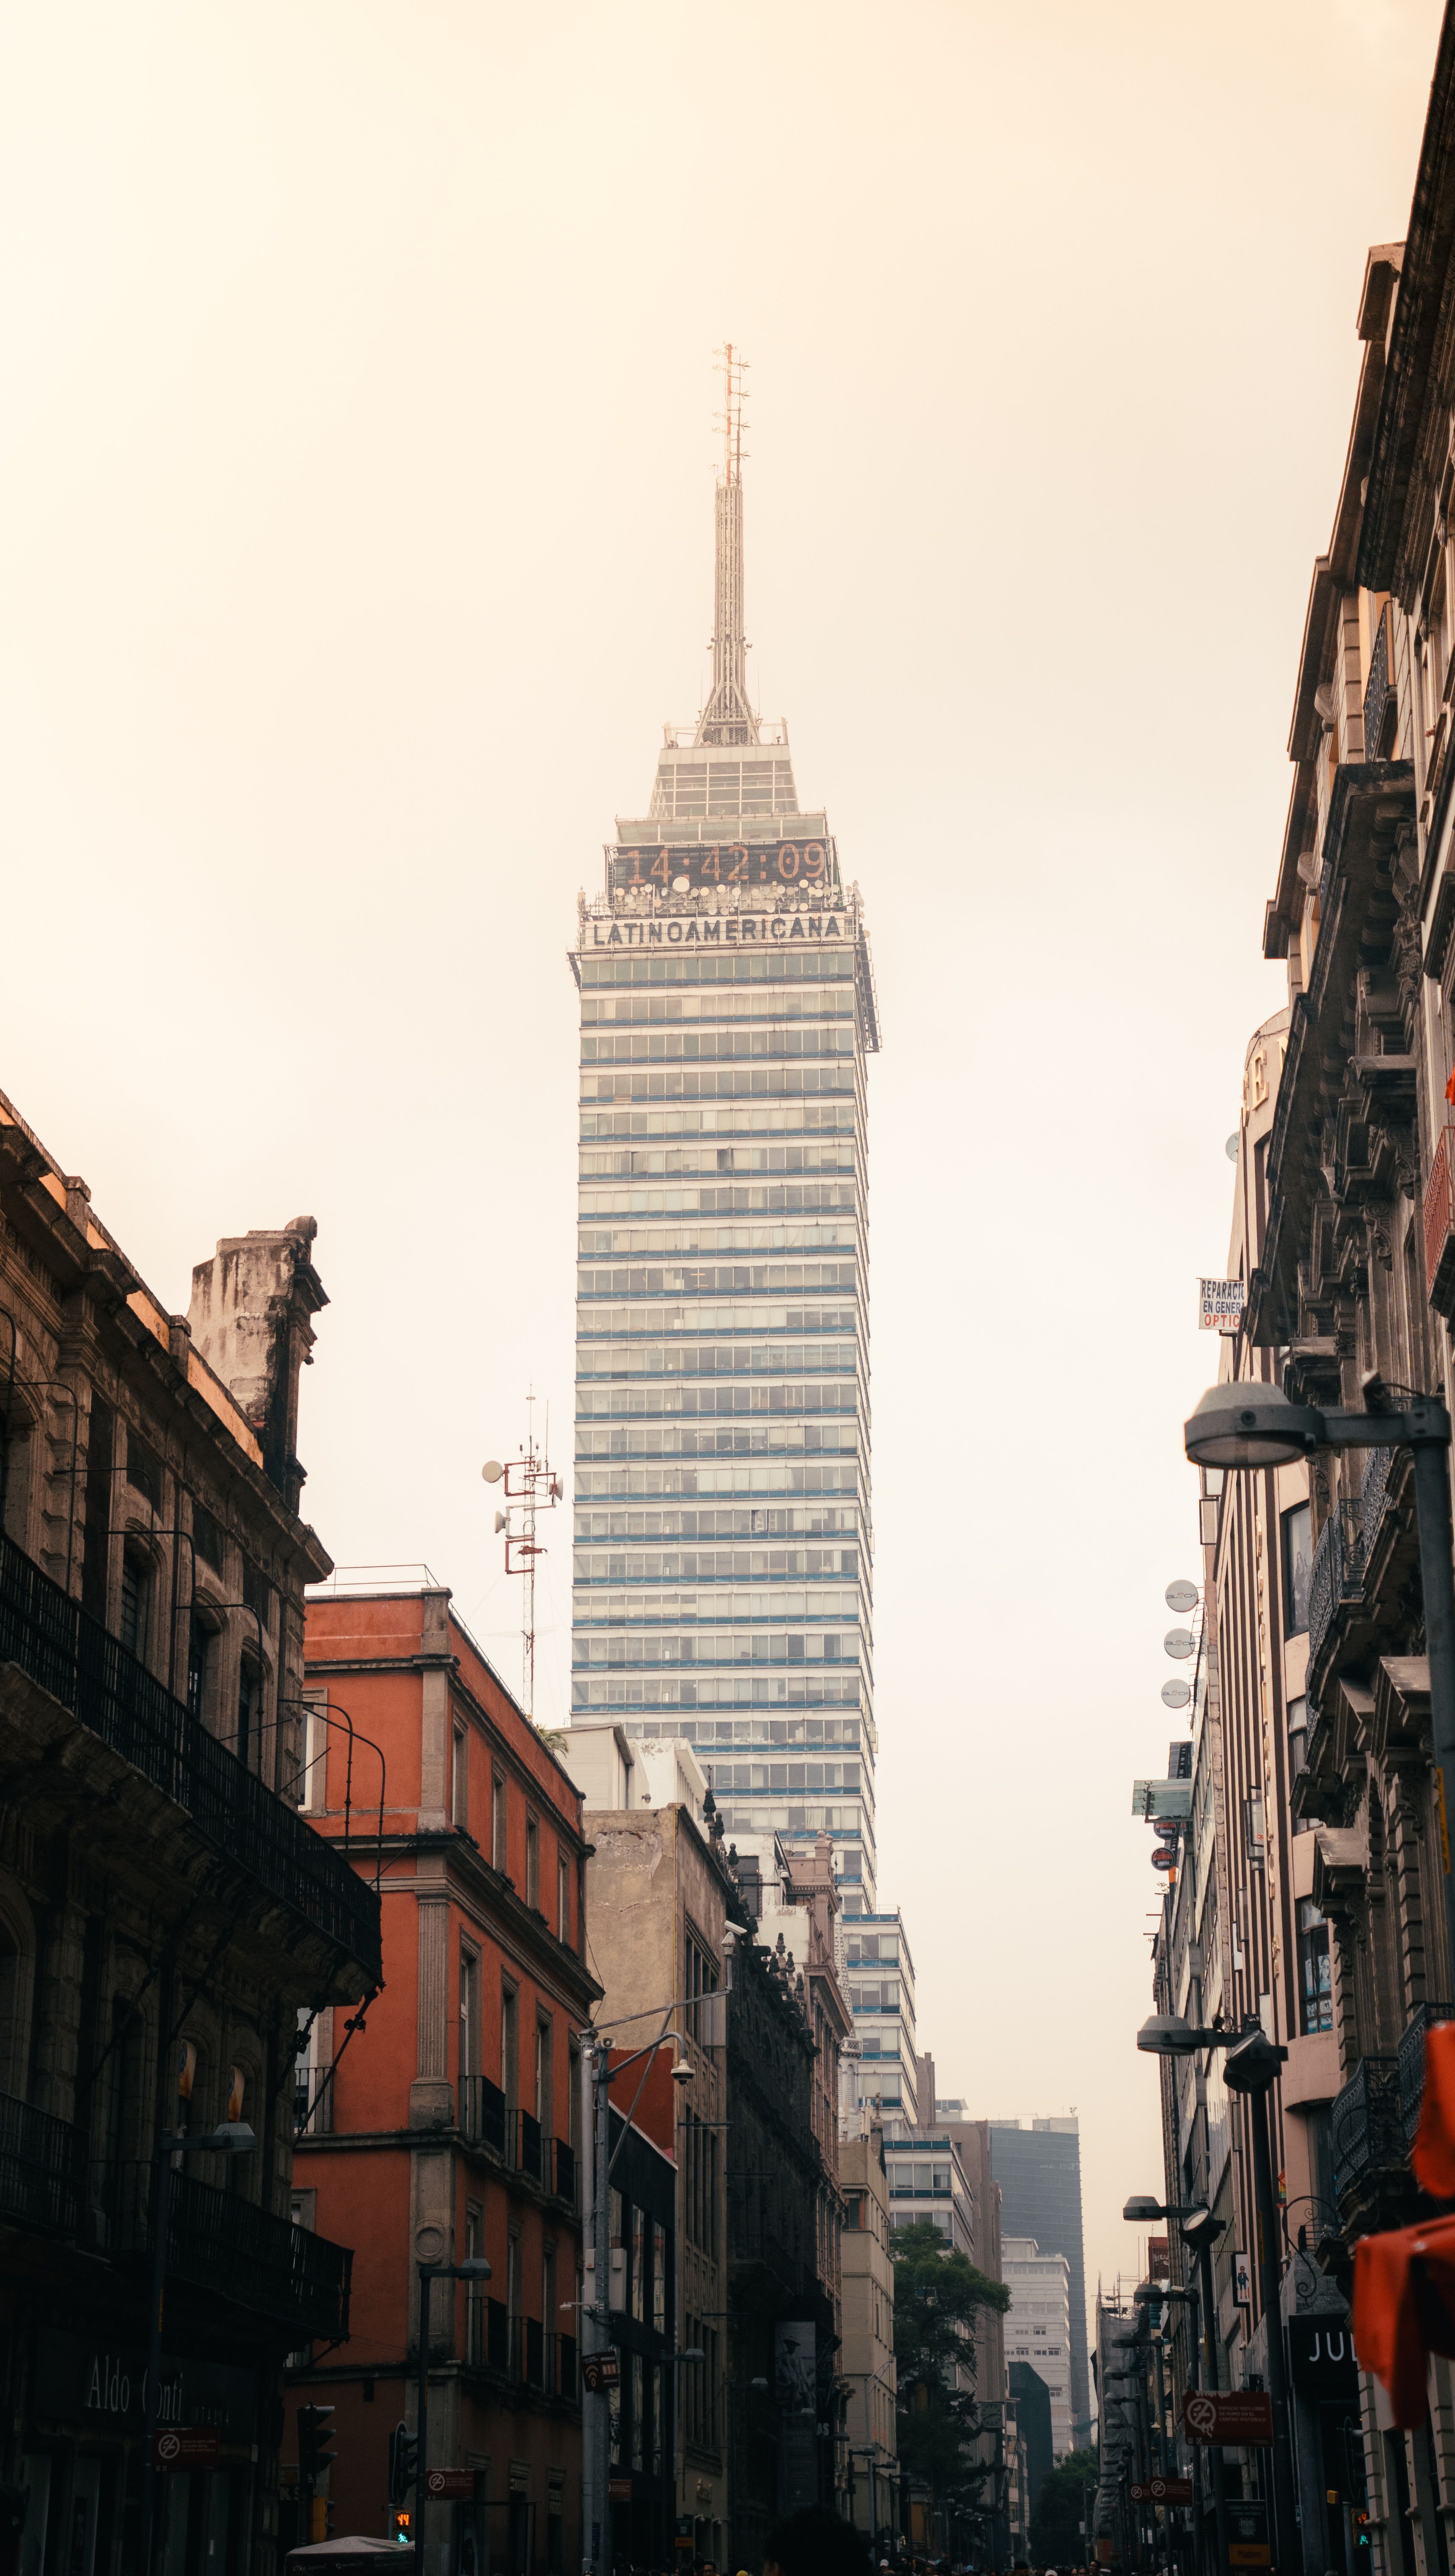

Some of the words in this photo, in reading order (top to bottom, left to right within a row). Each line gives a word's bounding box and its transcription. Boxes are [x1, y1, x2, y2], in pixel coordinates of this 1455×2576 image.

[628, 843, 825, 884] 14:42:09
[594, 916, 841, 945] LATINOAMERICANA
[1203, 1300, 1213, 1313] EN
[1204, 1313, 1240, 1327] OPTIC
[87, 2354, 130, 2413] Aldo
[1238, 2550, 1262, 2559] Madero
